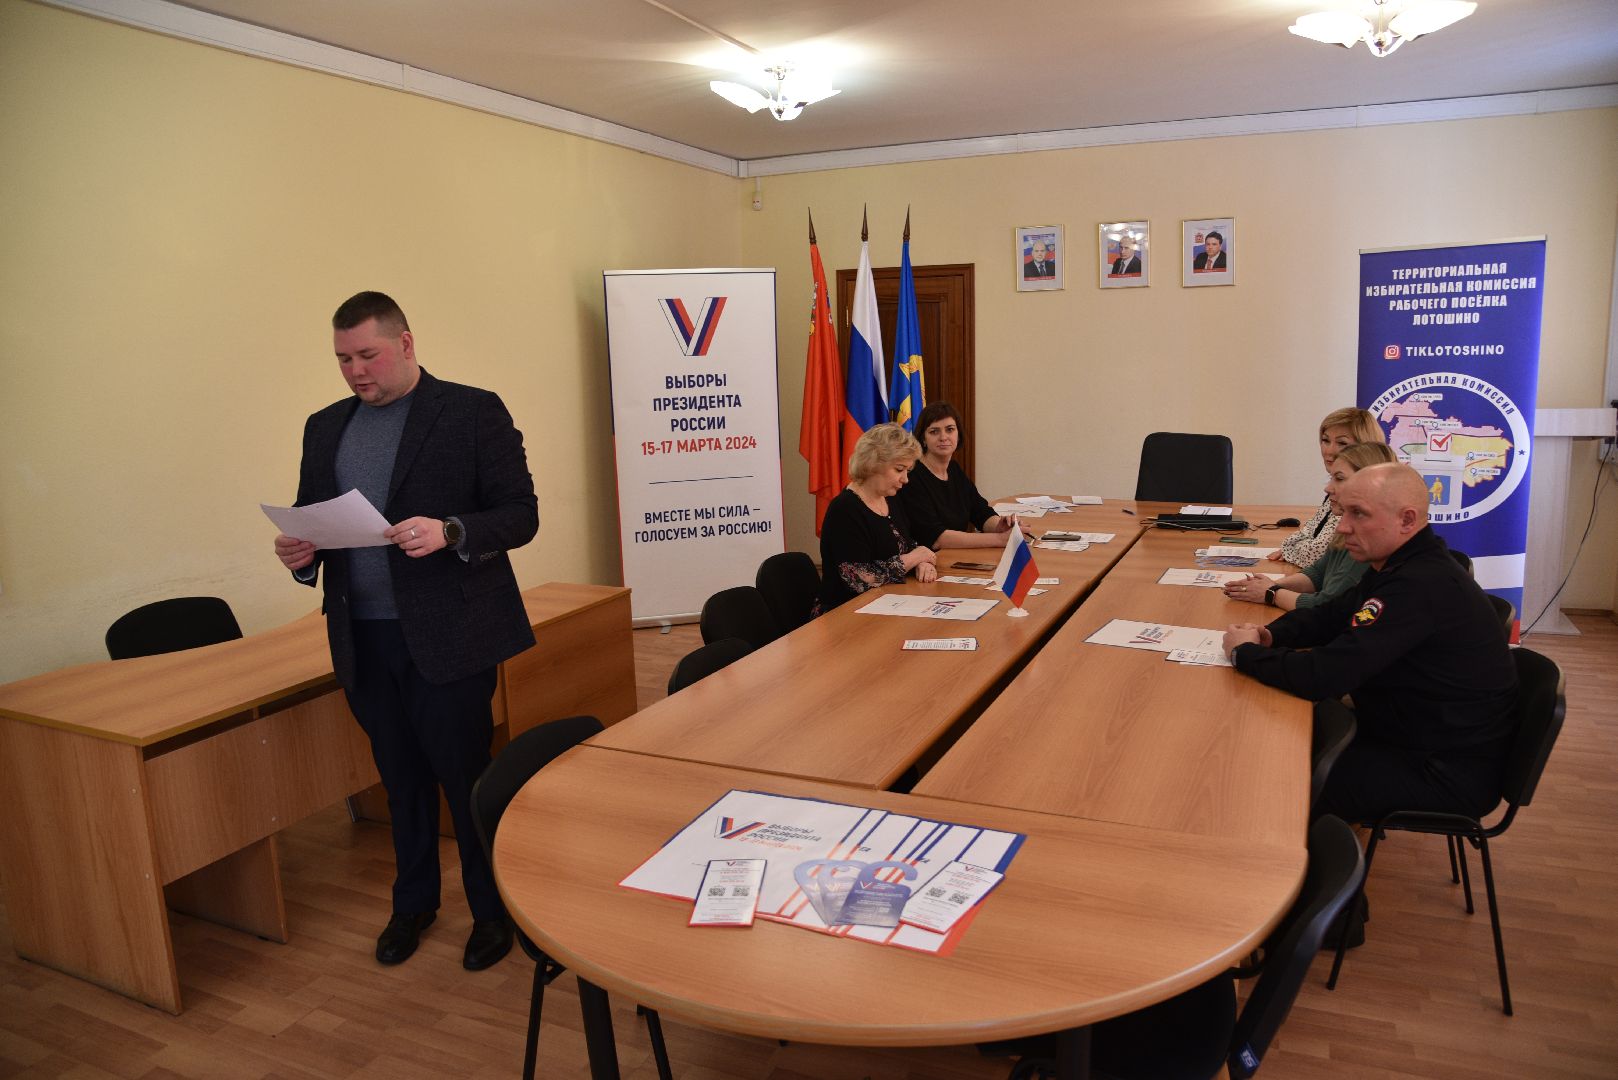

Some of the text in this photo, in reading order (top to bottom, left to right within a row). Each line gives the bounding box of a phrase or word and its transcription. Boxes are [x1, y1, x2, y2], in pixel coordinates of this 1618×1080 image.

[1392, 262, 1507, 280] ТЕРРИТОРИАЛЬНАЯ
[1366, 277, 1537, 297] ИЗБИРАТЕЛЬНАЯ КОМИССИЯ
[1389, 294, 1508, 311] РАБОЧЕГО ПОСЁЛКА
[1412, 312, 1480, 326] ЛОТОШИНО
[1405, 344, 1505, 357] TIKLOTOSHINO
[665, 373, 727, 390] ВЫБОРЫ
[653, 394, 742, 412] ПРЕЗИДЕНТА
[1372, 375, 1516, 415] ИЗБИРАТЕЛЬНАЯ КОМИССИЯ
[670, 416, 726, 432] РОССИИ
[641, 435, 757, 456] 15-17 МАРТА 2024
[644, 509, 691, 525] ВМЕСТЕ
[694, 507, 715, 520] МЫ
[719, 504, 750, 518] СИЛА
[1427, 510, 1470, 522] ОШИНО
[635, 520, 772, 543] ГОЛОСУЕМ ЗА РОССИЮ!
